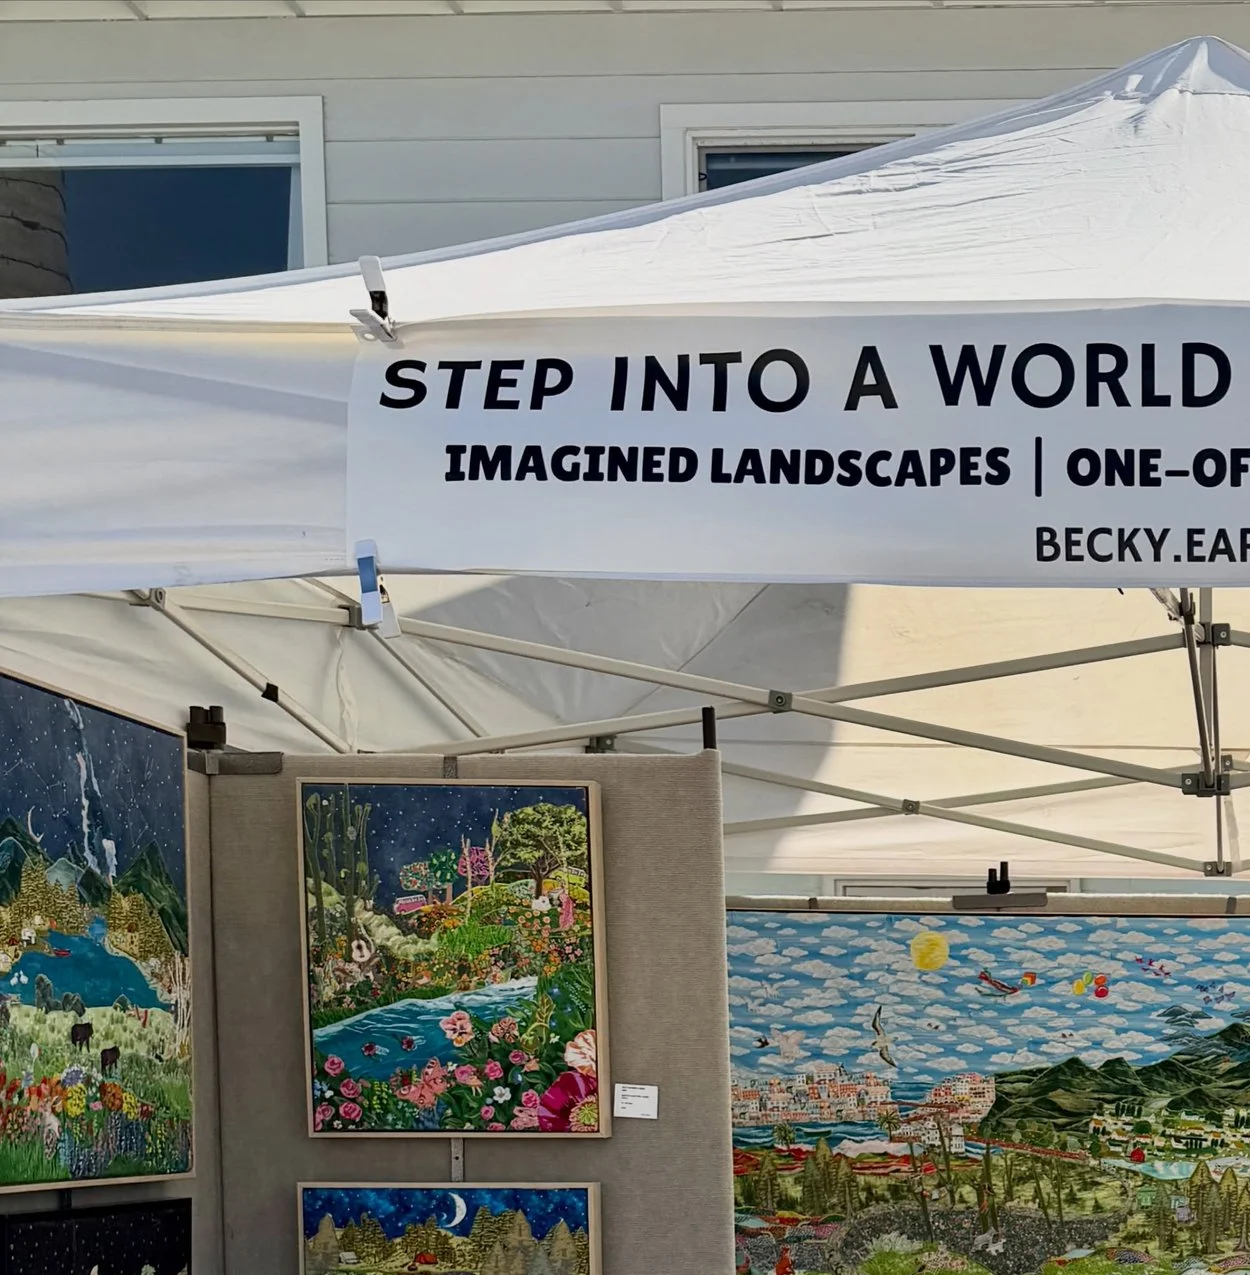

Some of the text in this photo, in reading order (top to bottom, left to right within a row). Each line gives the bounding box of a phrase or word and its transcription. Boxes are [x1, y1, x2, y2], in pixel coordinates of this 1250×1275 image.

[380, 359, 573, 410] STEP
[611, 349, 809, 412] INTO
[844, 346, 898, 411] A
[929, 343, 1231, 408] WORLD
[445, 445, 698, 482] IMAGINED
[711, 447, 1010, 487] LANDSCAPES
